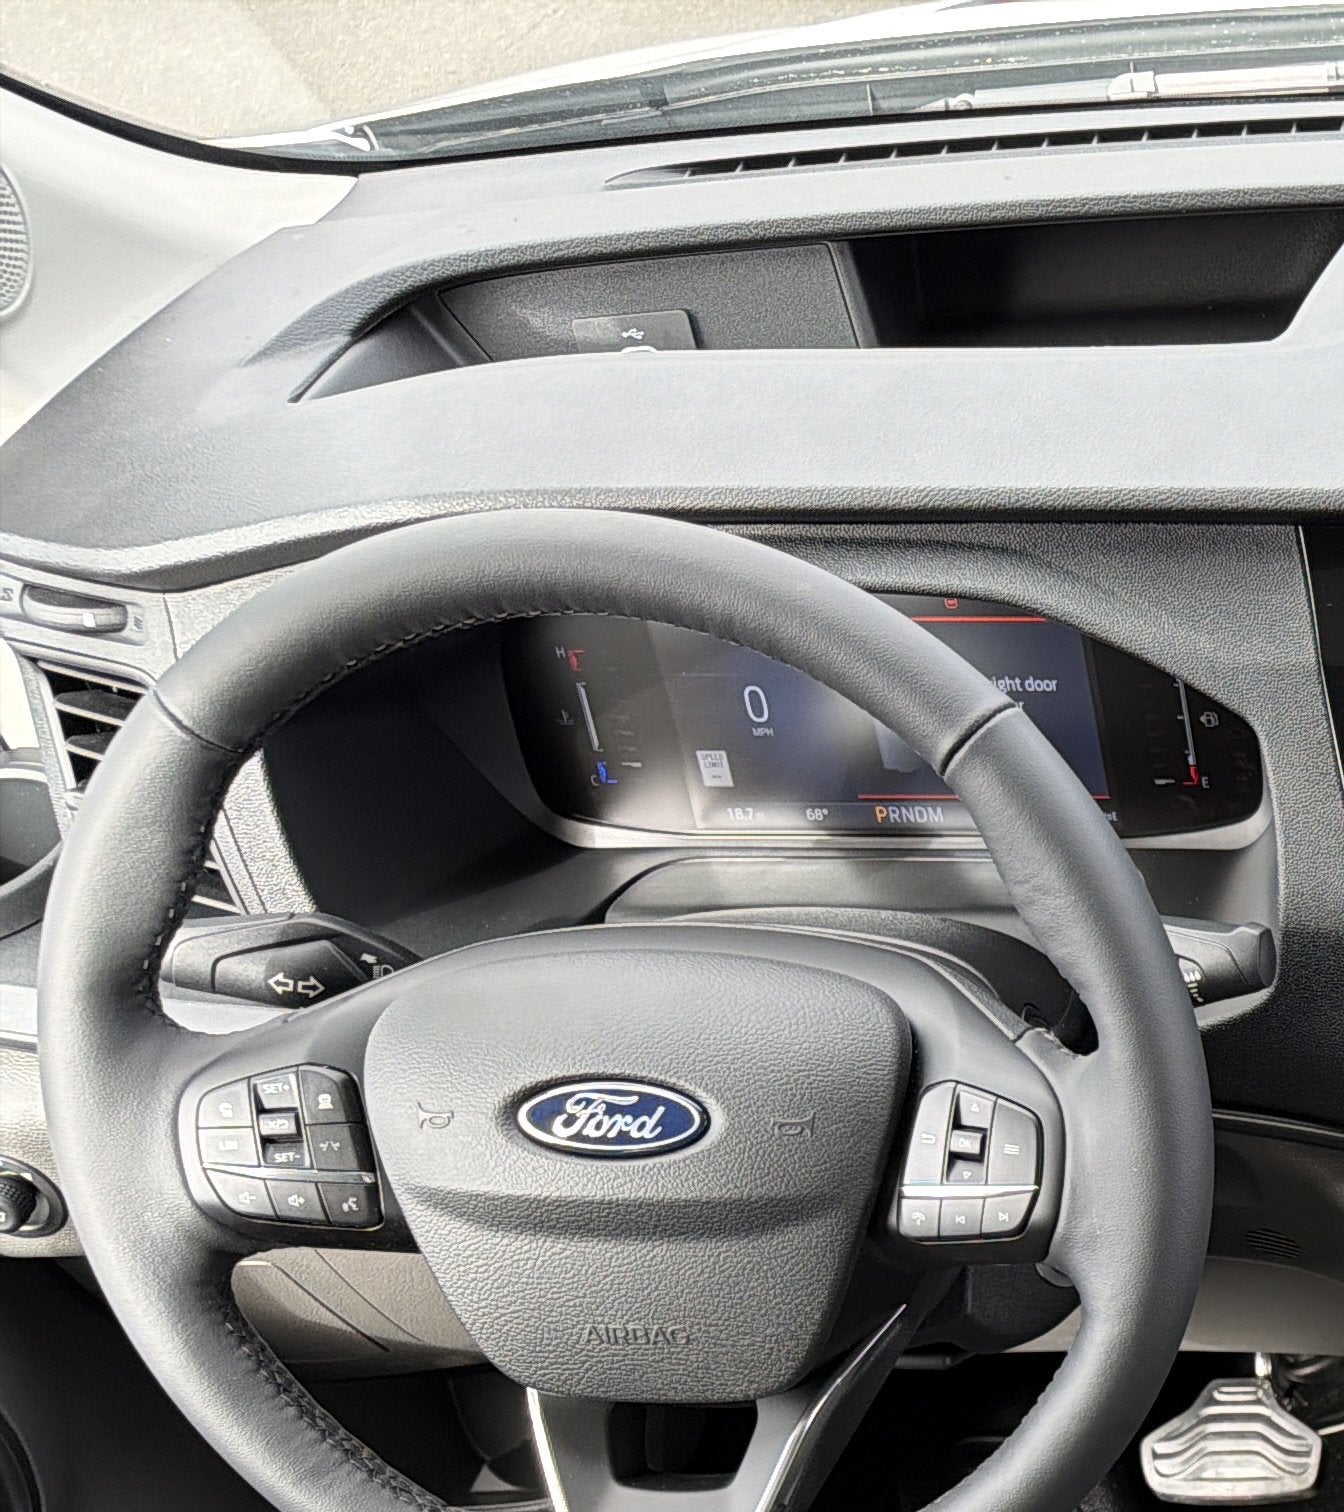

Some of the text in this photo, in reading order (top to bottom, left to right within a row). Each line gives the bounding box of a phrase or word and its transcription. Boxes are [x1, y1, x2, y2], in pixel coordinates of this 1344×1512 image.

[991, 675, 1058, 693] ight door
[743, 684, 769, 723] 0
[752, 726, 775, 737] MPH
[701, 752, 725, 761] SPEED
[1201, 776, 1211, 789] E
[727, 807, 754, 821] 18.7
[552, 1092, 663, 1140] Ford
[580, 1325, 694, 1346] AIRBAG
